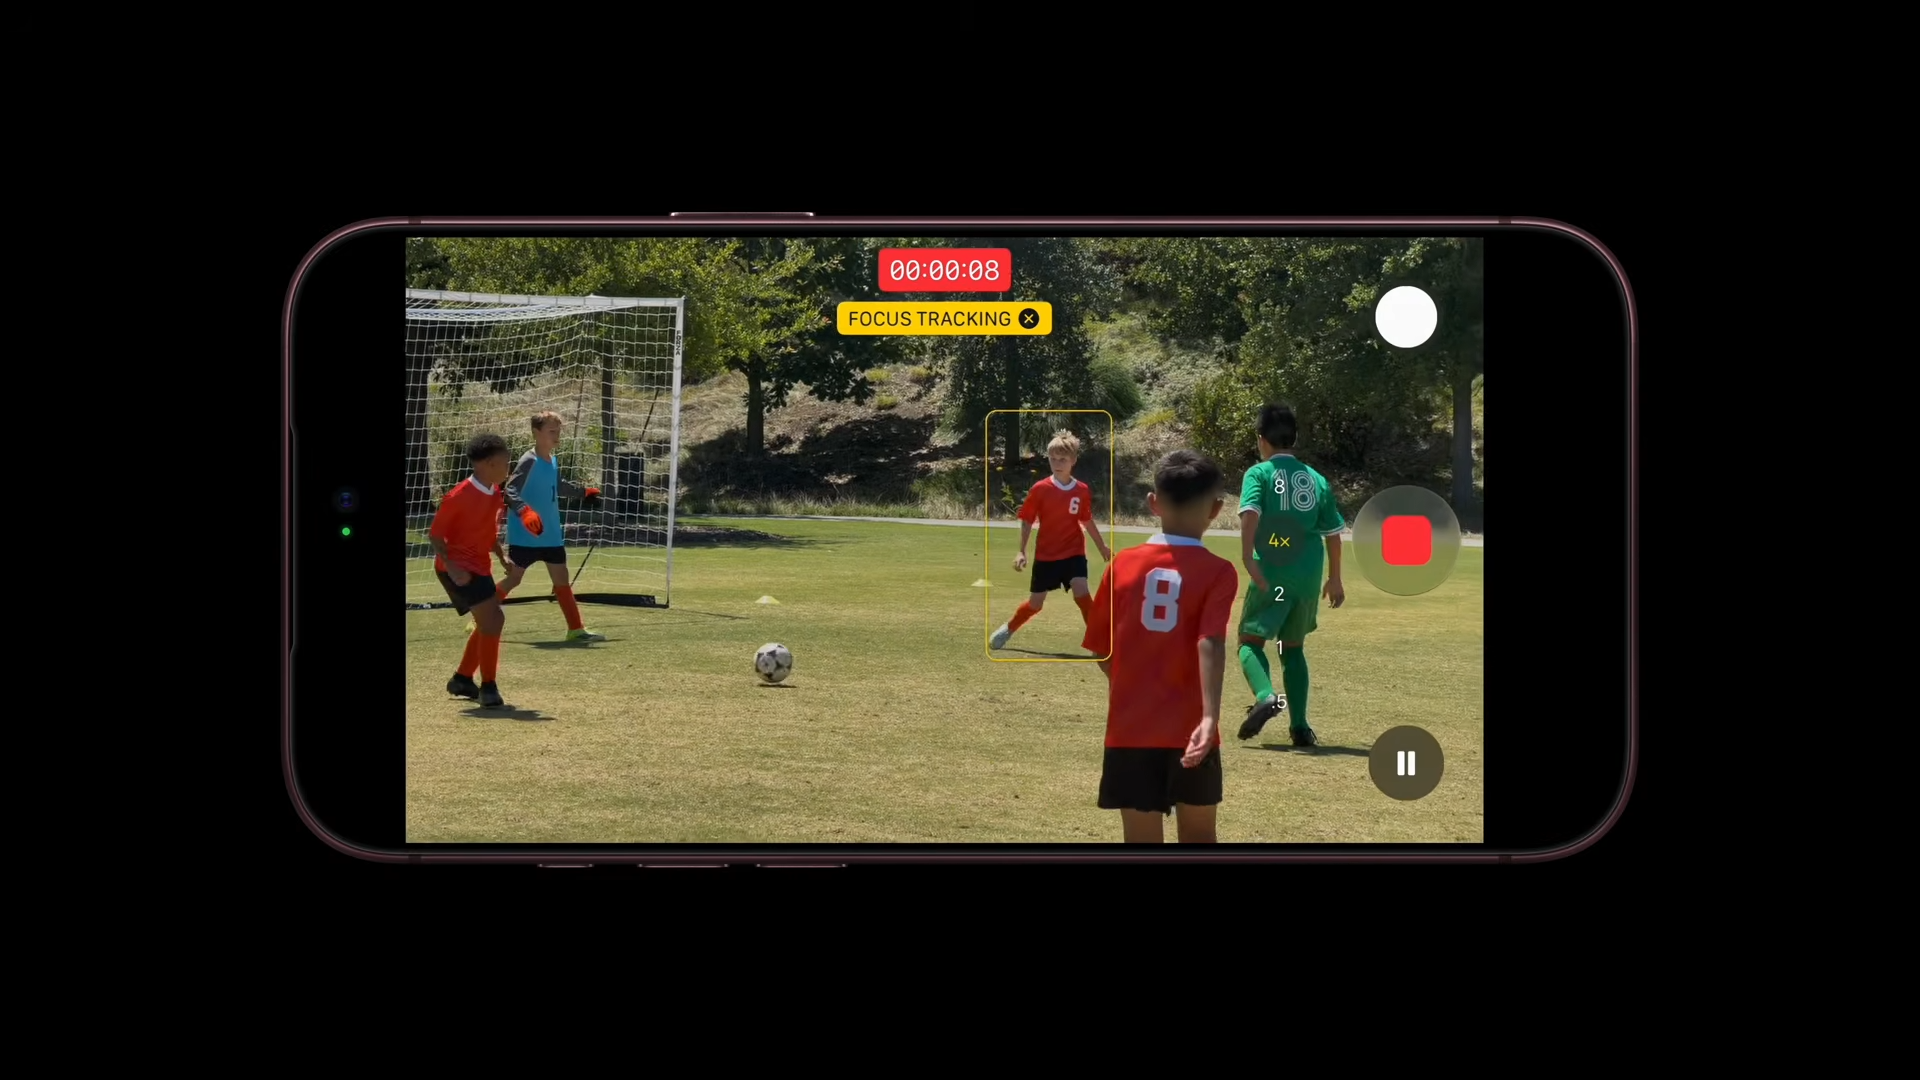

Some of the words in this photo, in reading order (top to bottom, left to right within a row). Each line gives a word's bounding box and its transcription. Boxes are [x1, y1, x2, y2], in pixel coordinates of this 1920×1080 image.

[890, 259, 1000, 281] 00:00:08
[848, 311, 912, 327] FOCUS
[917, 311, 1011, 327] TRACKING
[1274, 478, 1285, 494] 8
[1068, 496, 1080, 515] 6
[1140, 567, 1183, 633] 8
[1274, 586, 1285, 602] 2
[1276, 640, 1283, 655] 1
[1271, 694, 1287, 709] .5
